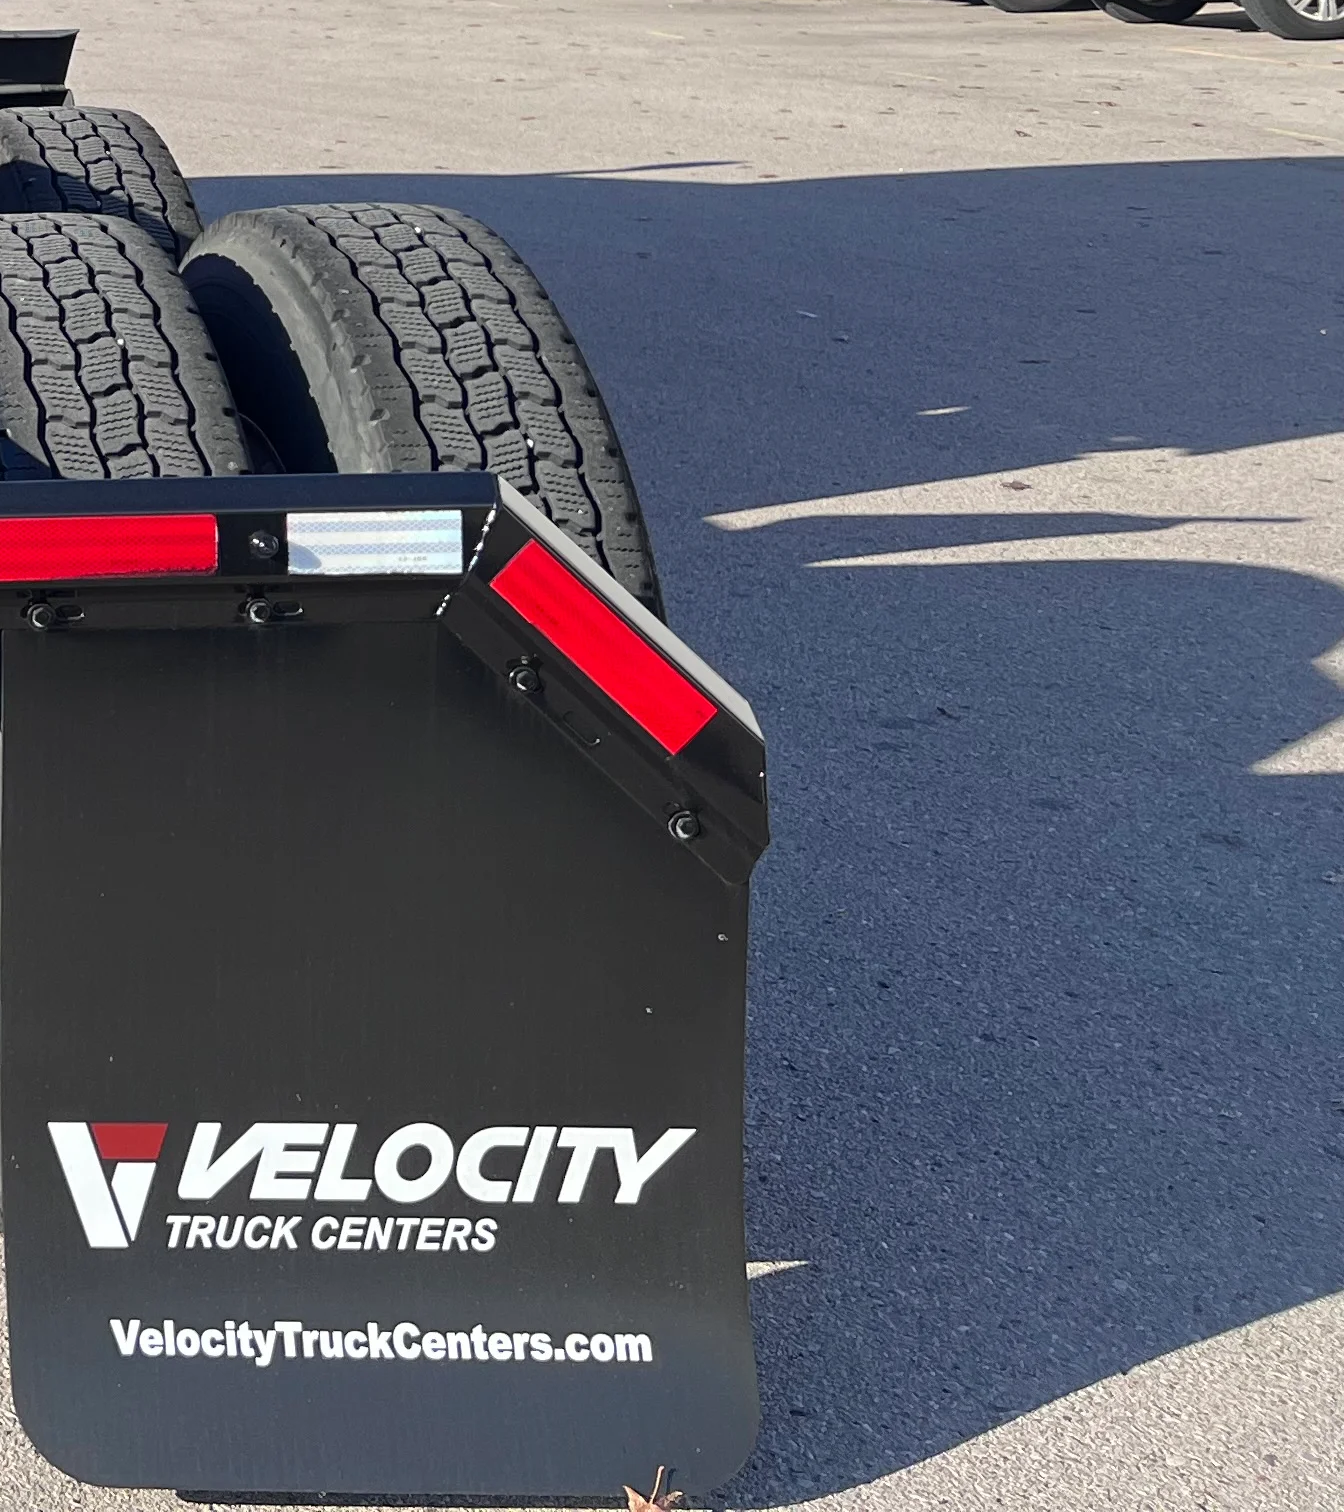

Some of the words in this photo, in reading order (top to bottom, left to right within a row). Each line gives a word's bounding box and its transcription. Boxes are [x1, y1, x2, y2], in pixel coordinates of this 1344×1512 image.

[176, 1121, 698, 1204] VELOCITY
[164, 1214, 302, 1249] TRUCK
[310, 1215, 499, 1253] CENTERS
[109, 1317, 655, 1368] VelocityTruckCenters.com
